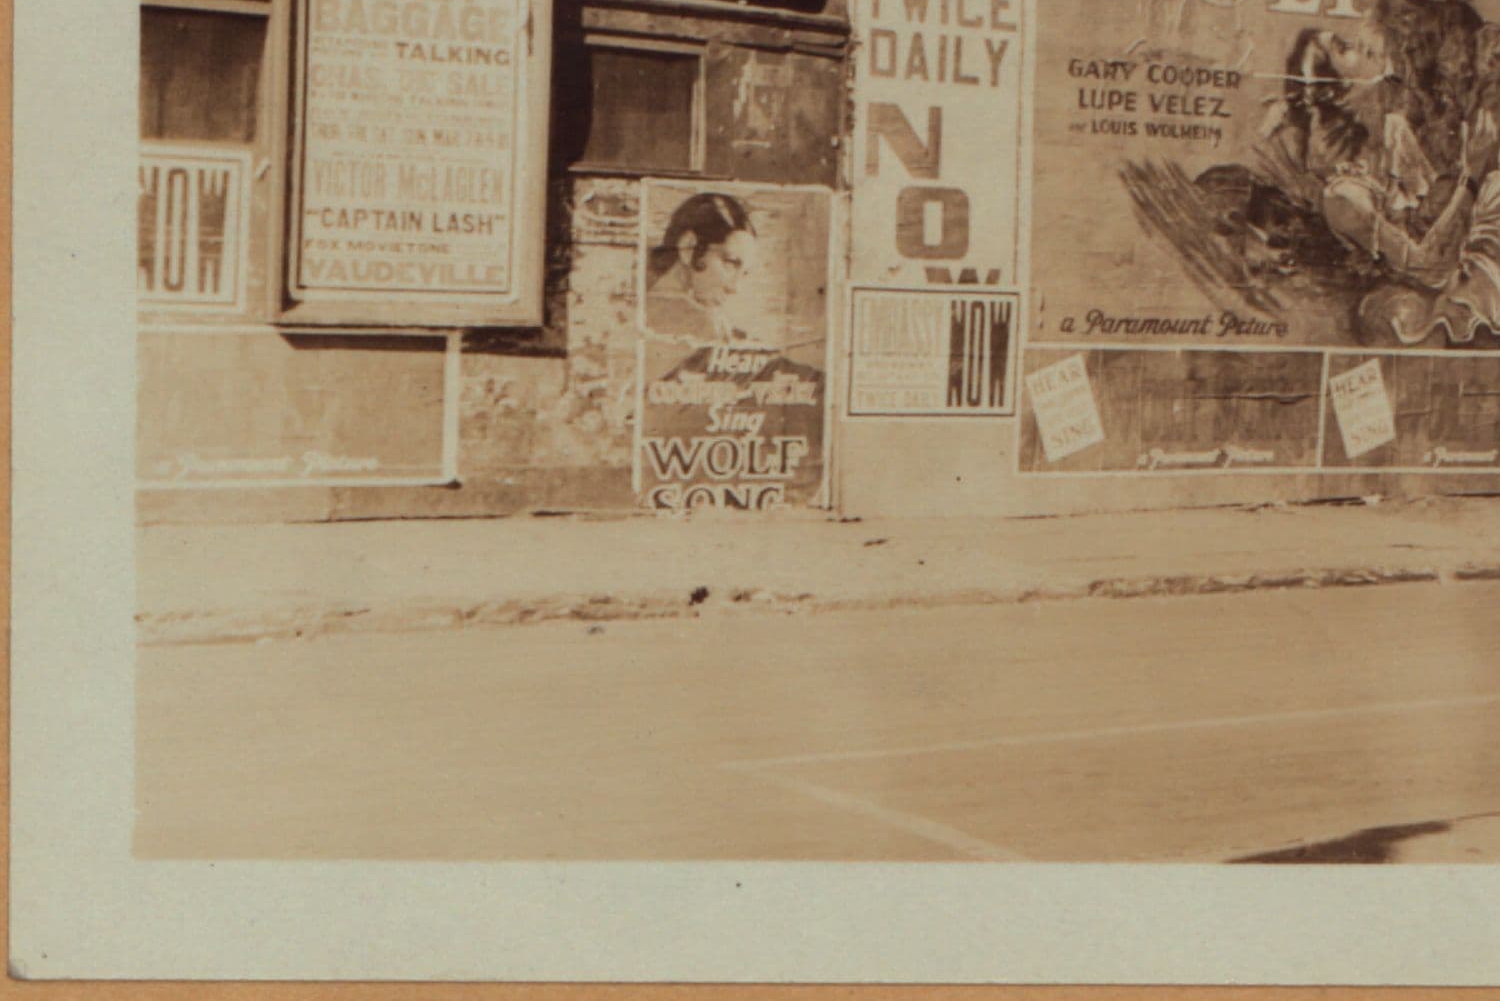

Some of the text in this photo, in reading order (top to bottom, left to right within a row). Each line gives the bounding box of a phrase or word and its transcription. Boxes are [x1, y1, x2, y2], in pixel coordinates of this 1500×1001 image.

[395, 41, 511, 67] TALKING
[870, 27, 1009, 88] DAILY
[1068, 58, 1242, 89] GARY COOPER
[1078, 87, 1233, 119] LUPE VELEZ
[1091, 119, 1138, 137] LOUIS
[312, 159, 387, 200] VICTOR
[348, 239, 450, 255] MOVIETONE
[303, 258, 505, 286] VAUDEVILLE
[1060, 316, 1075, 334] a
[1083, 308, 1215, 336] Paramount
[705, 347, 769, 379] Hear
[945, 299, 1013, 409] NOW
[705, 404, 767, 438] Sing
[642, 436, 810, 481] WOLF
